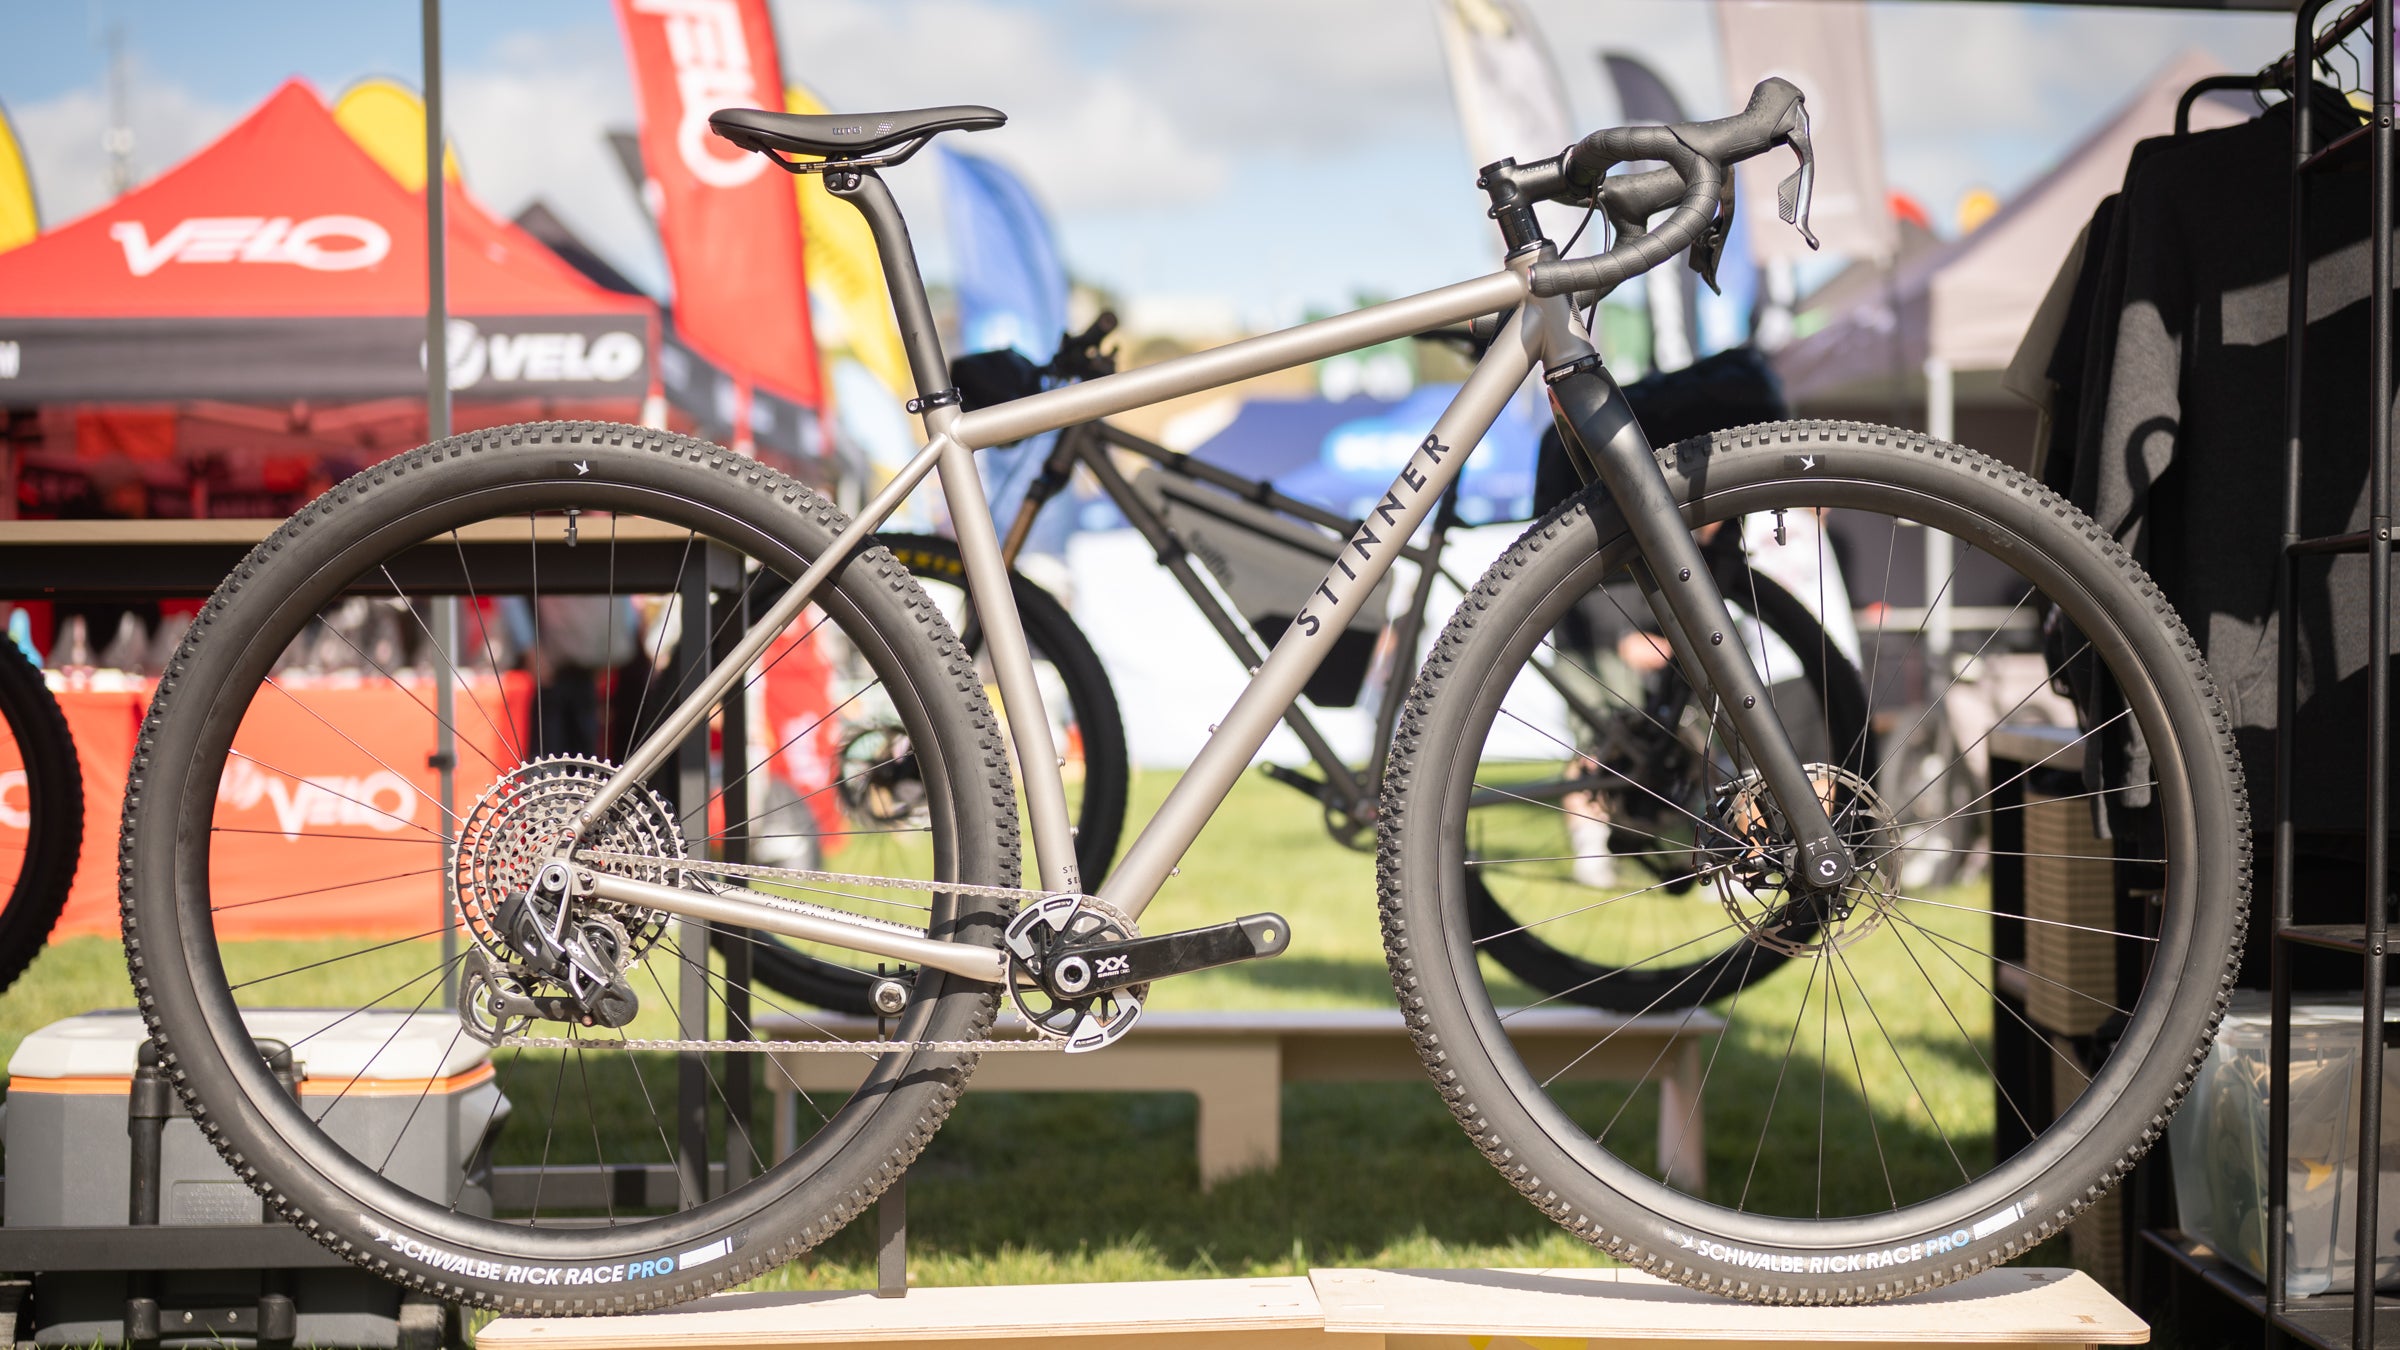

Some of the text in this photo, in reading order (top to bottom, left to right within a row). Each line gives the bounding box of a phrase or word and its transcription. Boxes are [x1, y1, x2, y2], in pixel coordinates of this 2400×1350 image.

[629, 0, 774, 188] ELO
[109, 215, 392, 278] VELO
[487, 331, 644, 382] VELO
[1296, 434, 1450, 637] STINNER
[264, 769, 418, 843] VELO
[874, 917, 928, 932] BARBAR
[1095, 954, 1129, 973] XX
[391, 1235, 674, 1286] SCHWALBE RICK RACE PRO
[1697, 1229, 1970, 1274] SCHWALBE RICK RACE PRO
